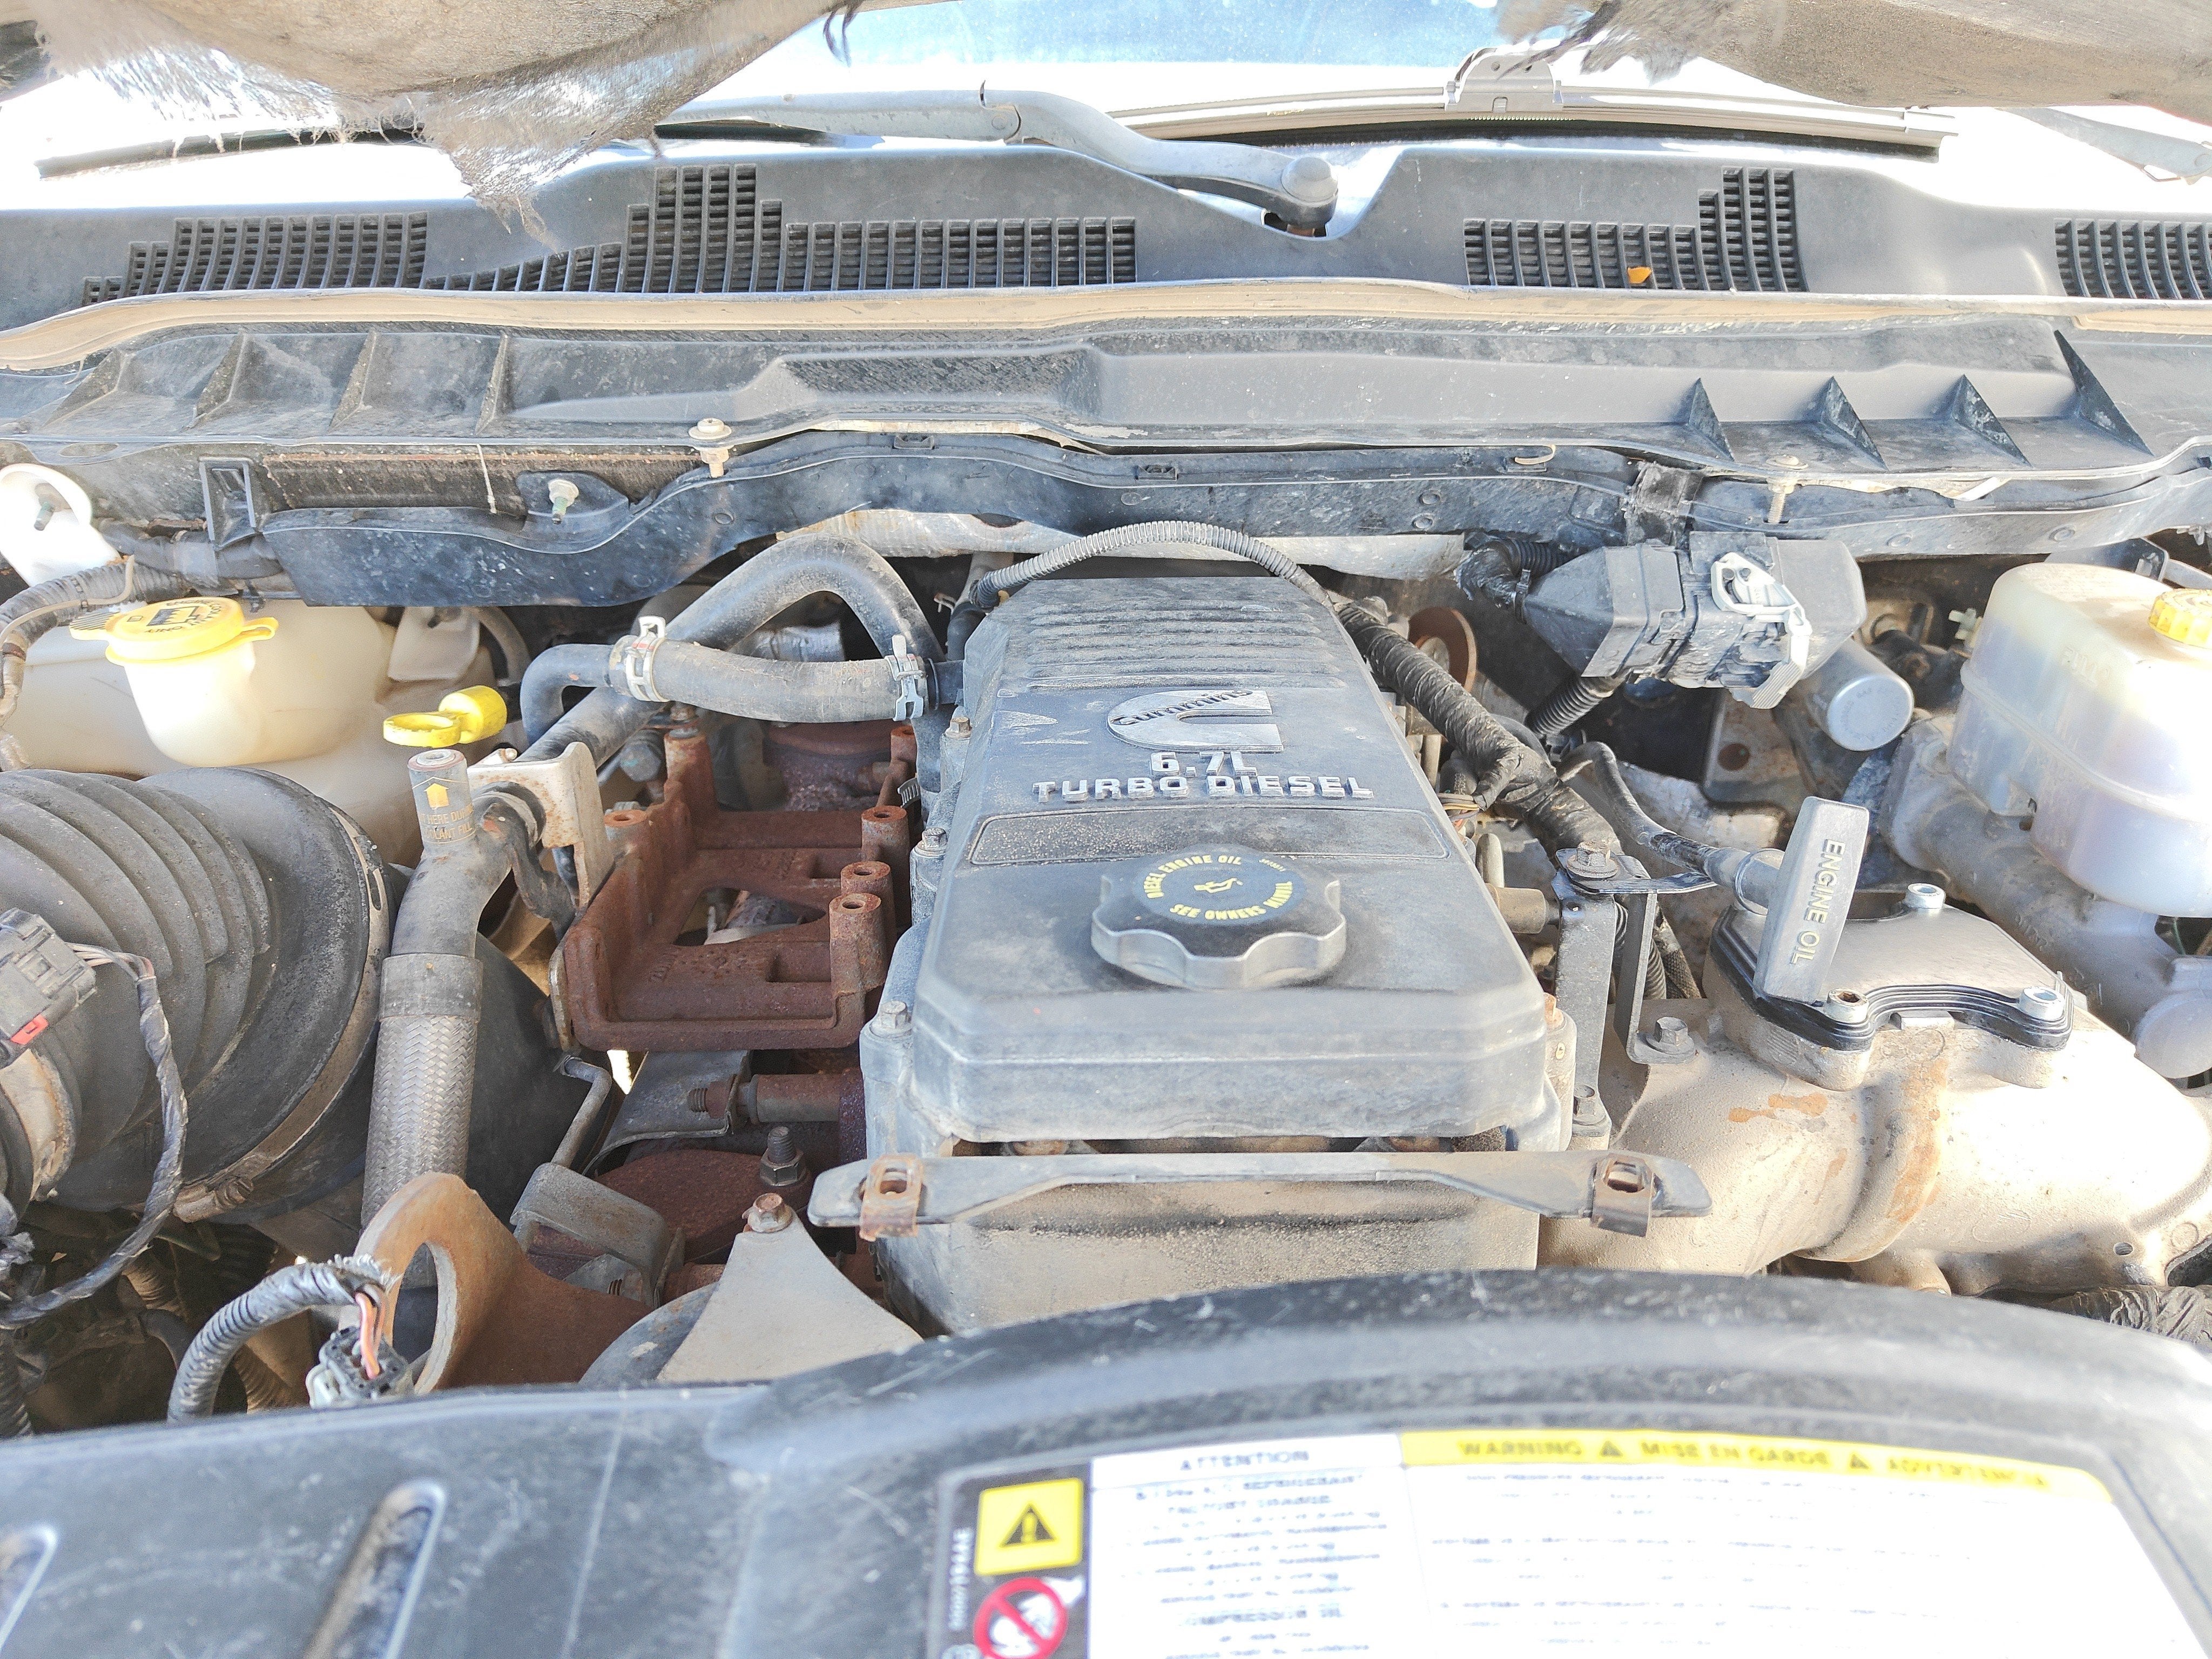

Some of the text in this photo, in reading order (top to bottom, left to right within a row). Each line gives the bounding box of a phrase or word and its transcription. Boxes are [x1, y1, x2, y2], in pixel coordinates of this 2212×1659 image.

[1149, 751, 1259, 777] 6.7L
[1032, 775, 1374, 803] TURBO DIESEL
[1157, 854, 1213, 874] ENGINE
[1218, 854, 1242, 866] OIL
[1169, 903, 1202, 919] SEE
[1205, 905, 1267, 920] OWNERS
[1789, 838, 1846, 965] ENGINE OIL
[1459, 1440, 1583, 1456] WARNING
[1710, 1444, 1740, 1460] EN
[1180, 1451, 1310, 1472] ATTENTION
